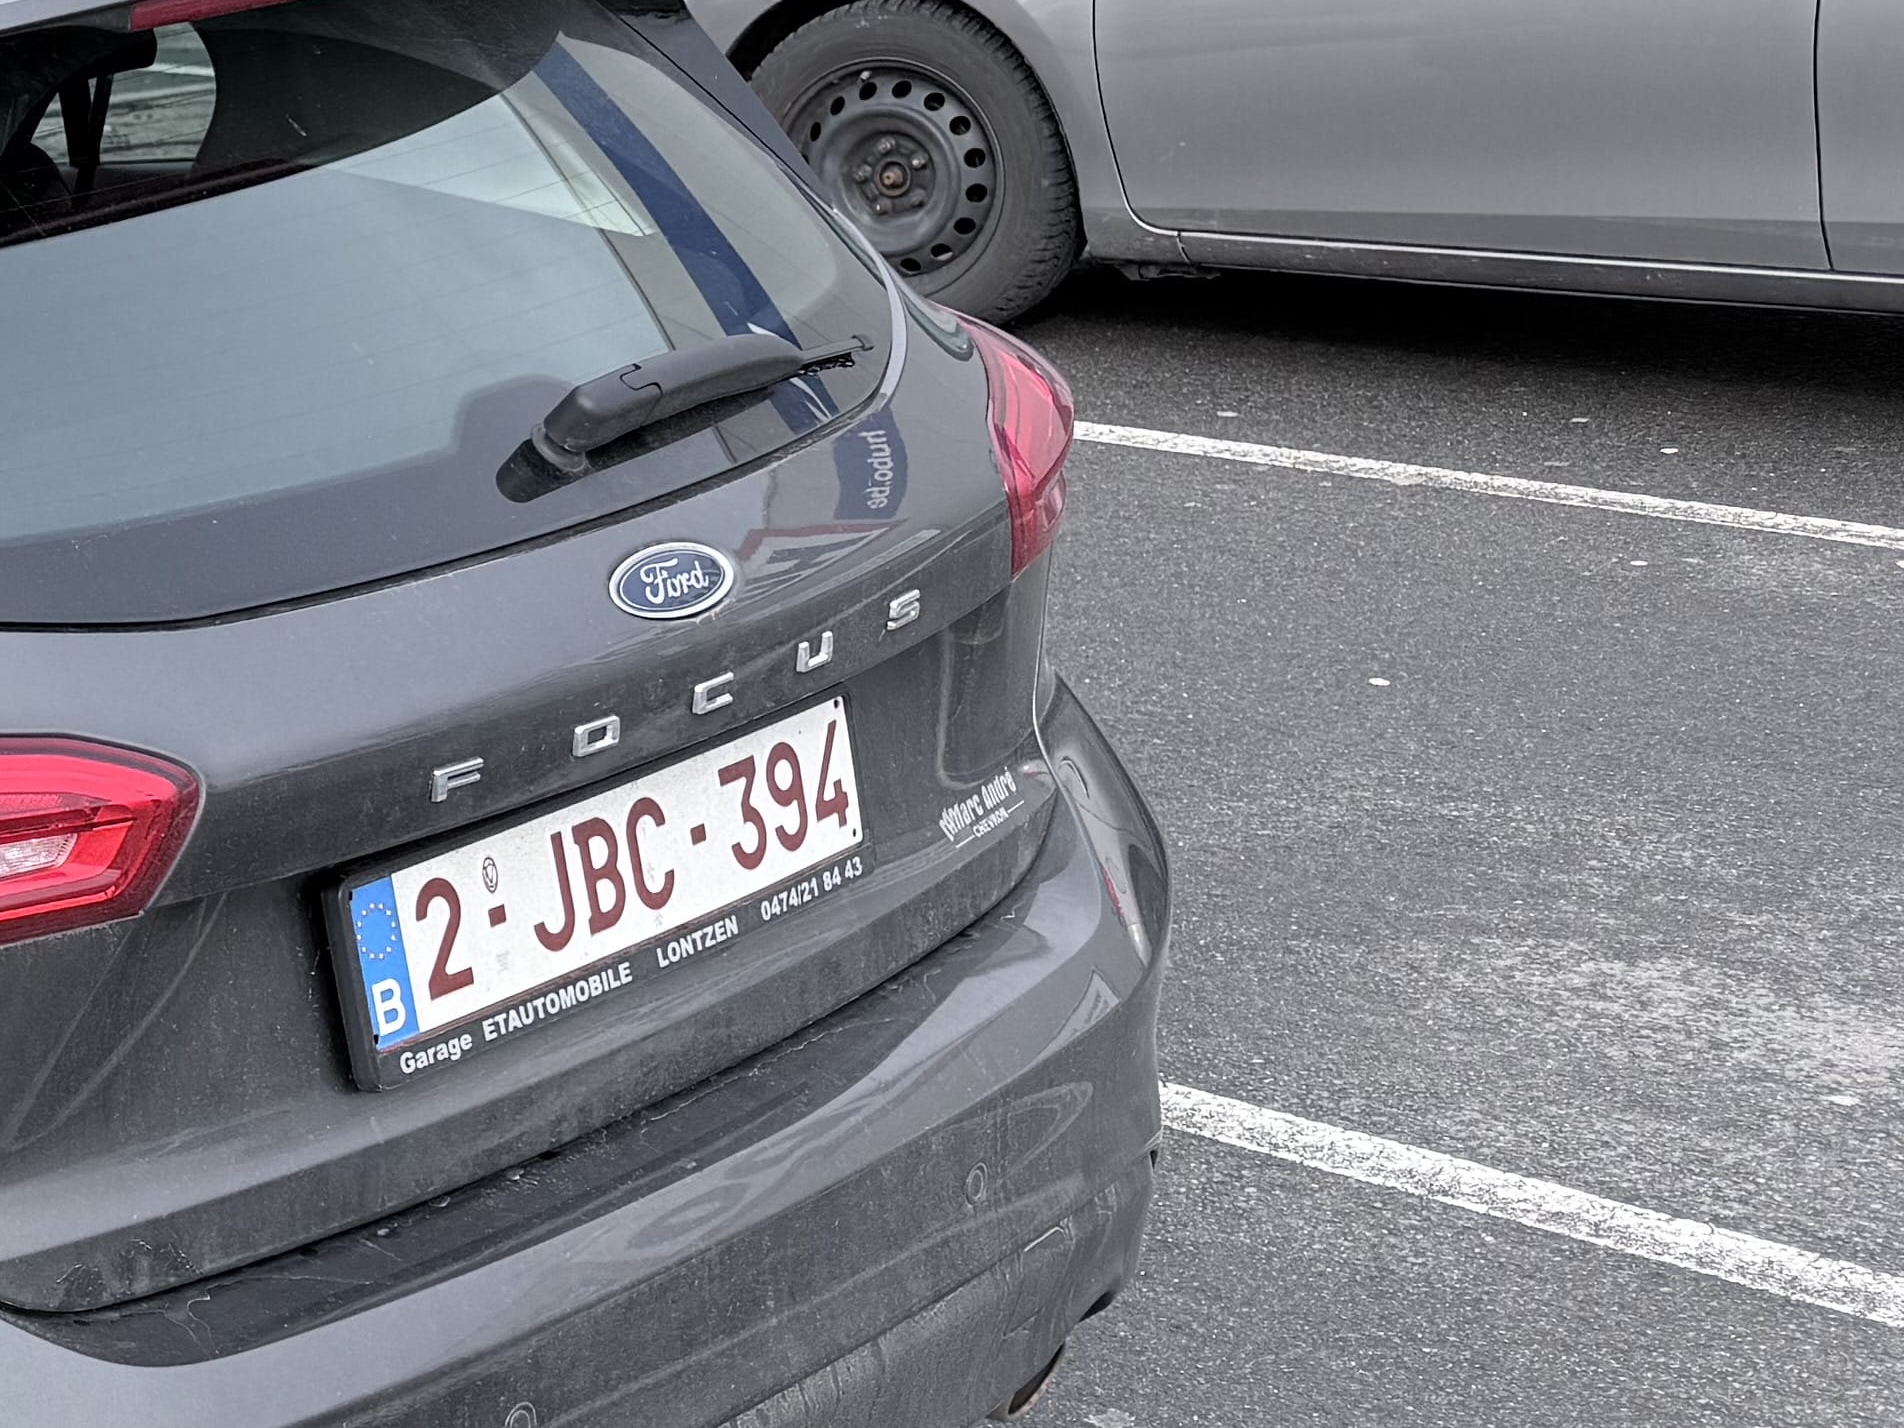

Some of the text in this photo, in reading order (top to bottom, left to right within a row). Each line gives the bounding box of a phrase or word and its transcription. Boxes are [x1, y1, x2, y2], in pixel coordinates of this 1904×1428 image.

[639, 557, 710, 604] Ford
[430, 589, 922, 803] FOCUS
[399, 856, 863, 1074] Garage ETAUTOMOBILE LONTZEN 0474/21 84 43
[415, 719, 850, 1001] 2-JBC-394
[371, 978, 407, 1037] B
